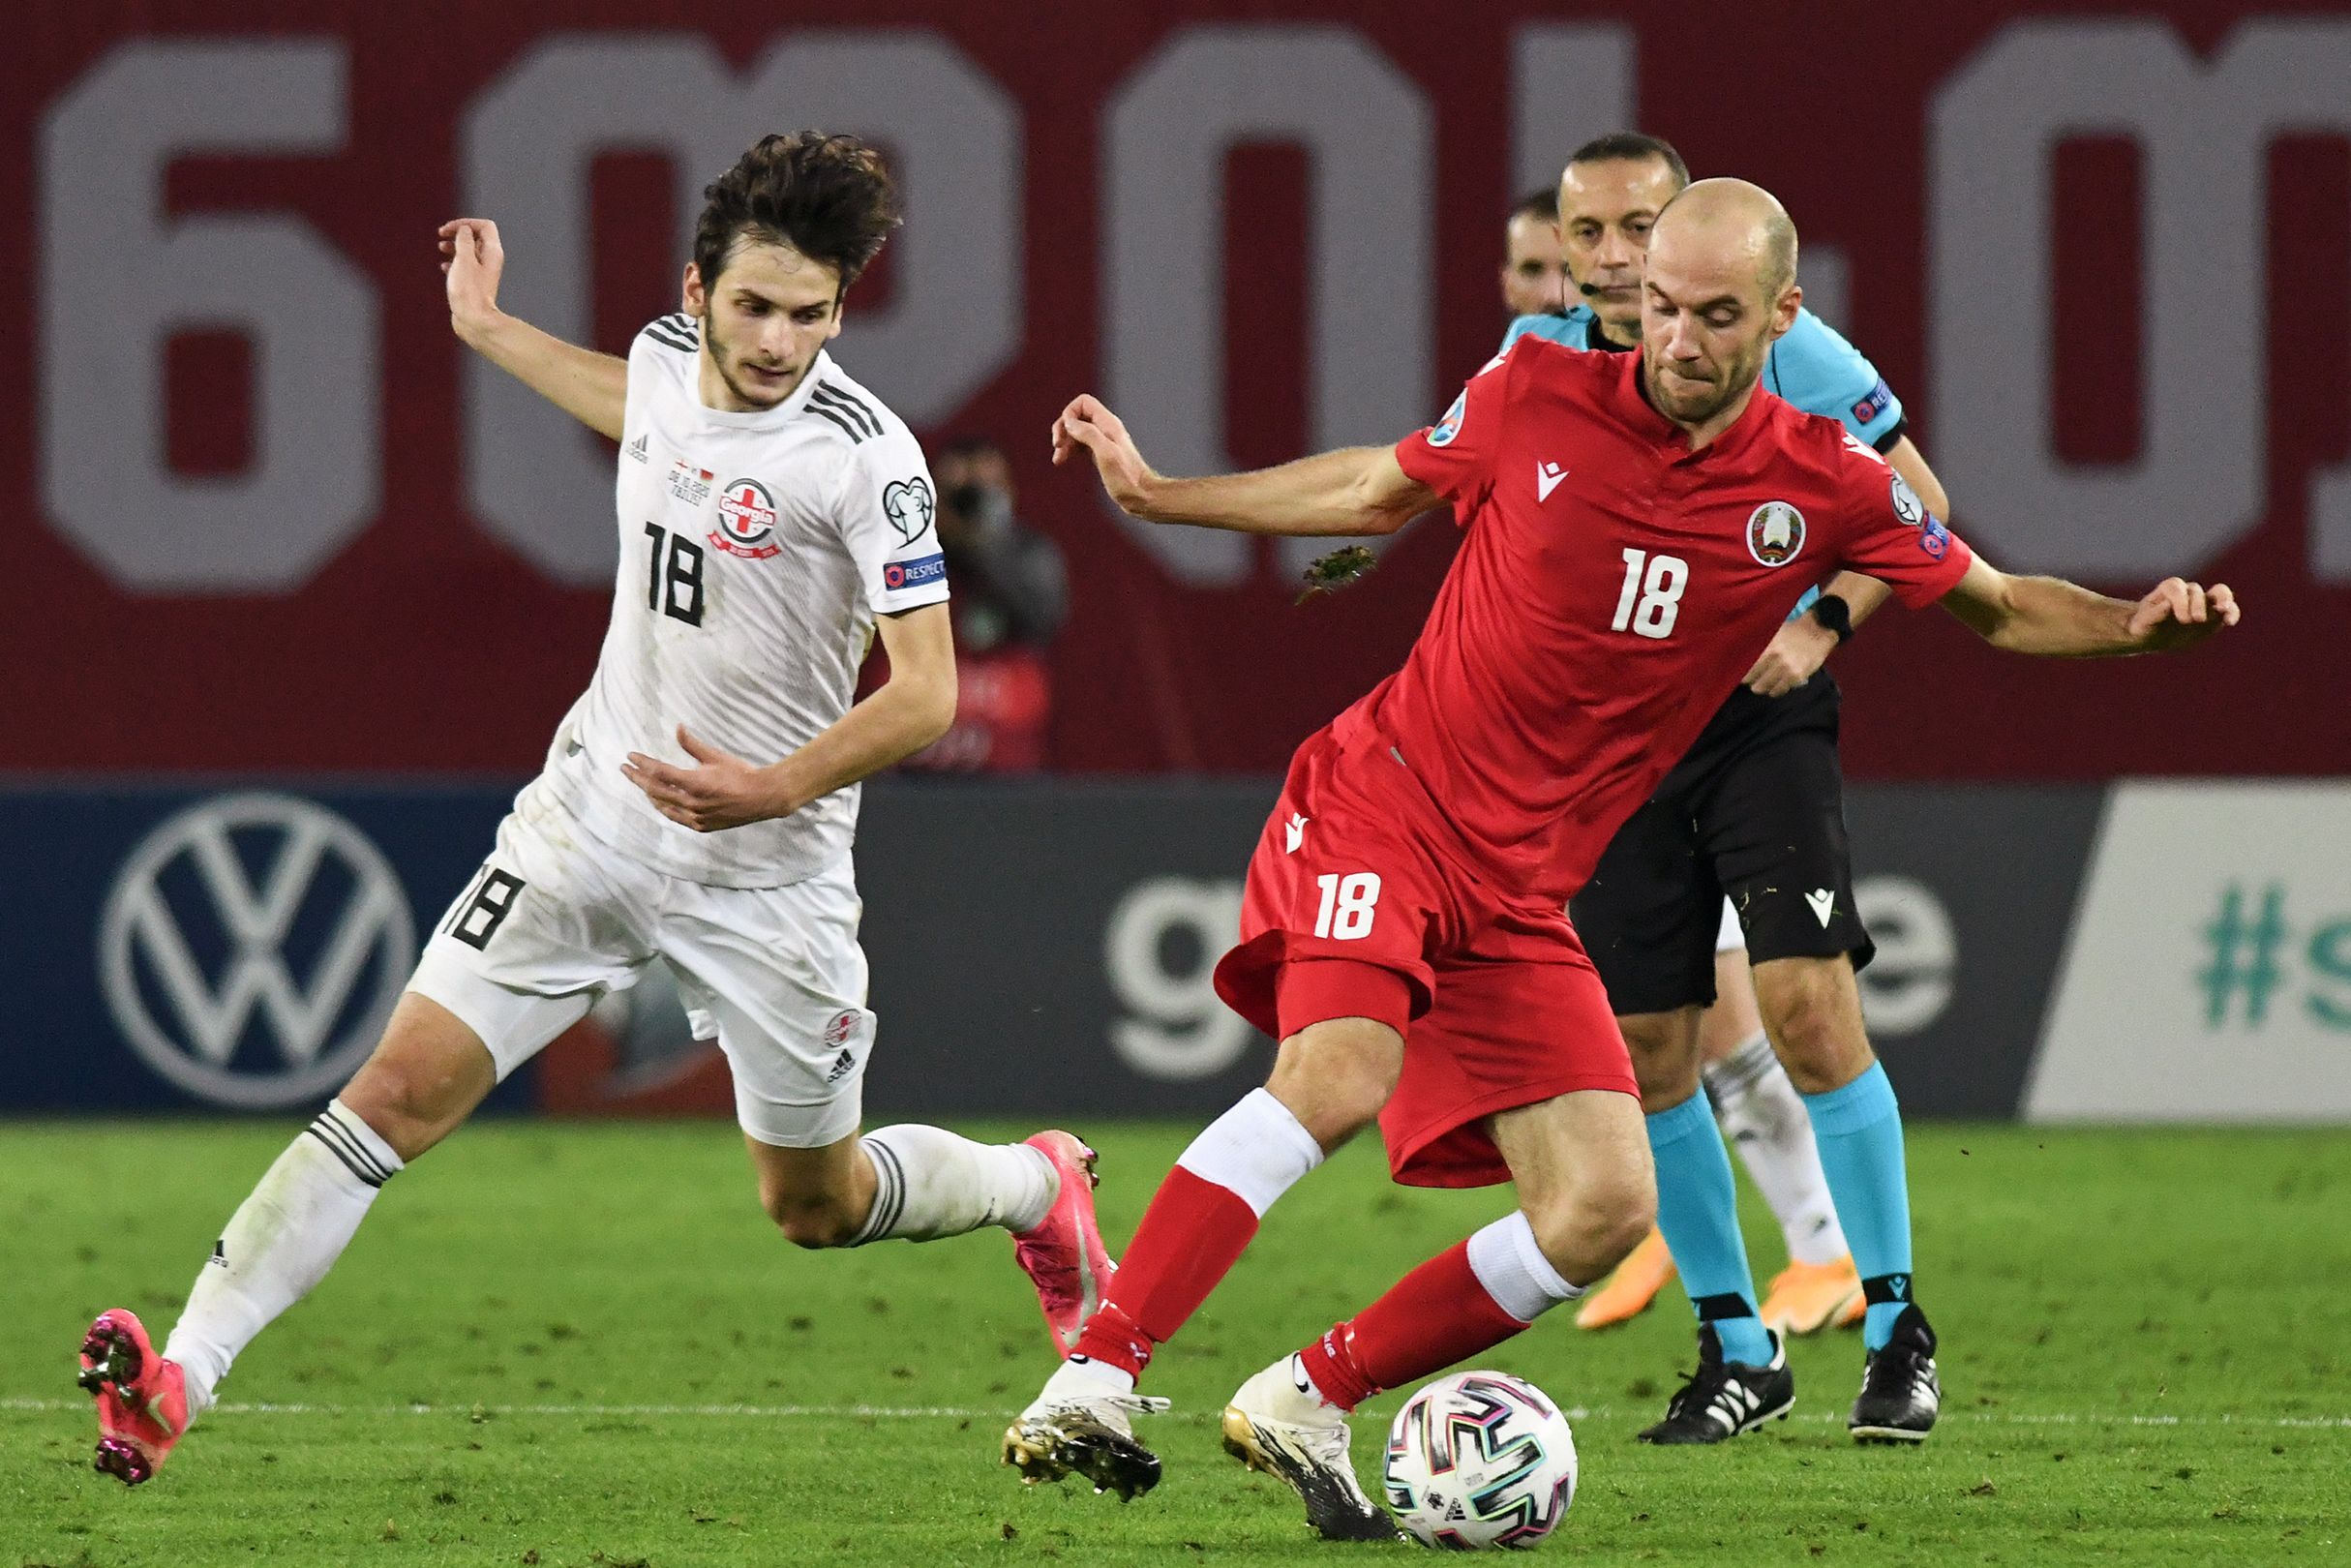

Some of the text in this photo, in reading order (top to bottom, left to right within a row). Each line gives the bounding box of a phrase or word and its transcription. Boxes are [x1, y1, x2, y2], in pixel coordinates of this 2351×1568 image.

[720, 497, 775, 525] Georgia
[645, 521, 704, 628] 18
[905, 559, 945, 581] RESPECT
[1611, 548, 1689, 639] 18
[442, 863, 527, 952] 18
[1313, 872, 1382, 941] 18
